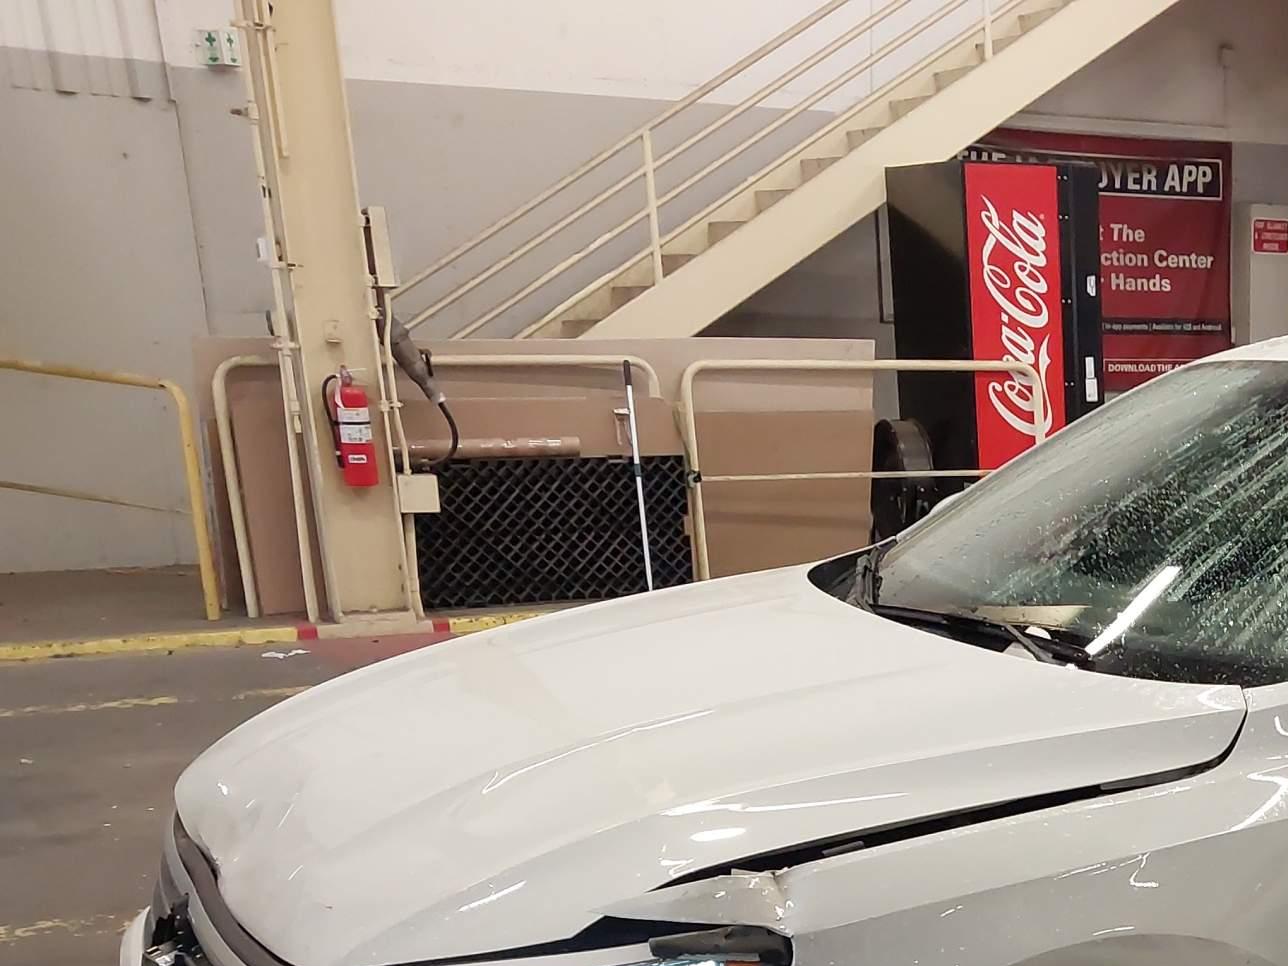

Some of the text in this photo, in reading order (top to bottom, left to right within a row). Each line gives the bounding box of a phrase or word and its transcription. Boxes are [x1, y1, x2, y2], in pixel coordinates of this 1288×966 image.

[1098, 161, 1213, 193] UYER APP
[1110, 223, 1145, 242] The
[1100, 249, 1214, 269] ction Center
[1110, 272, 1172, 292] Hands
[1108, 363, 1156, 373] DOWNLOAD
